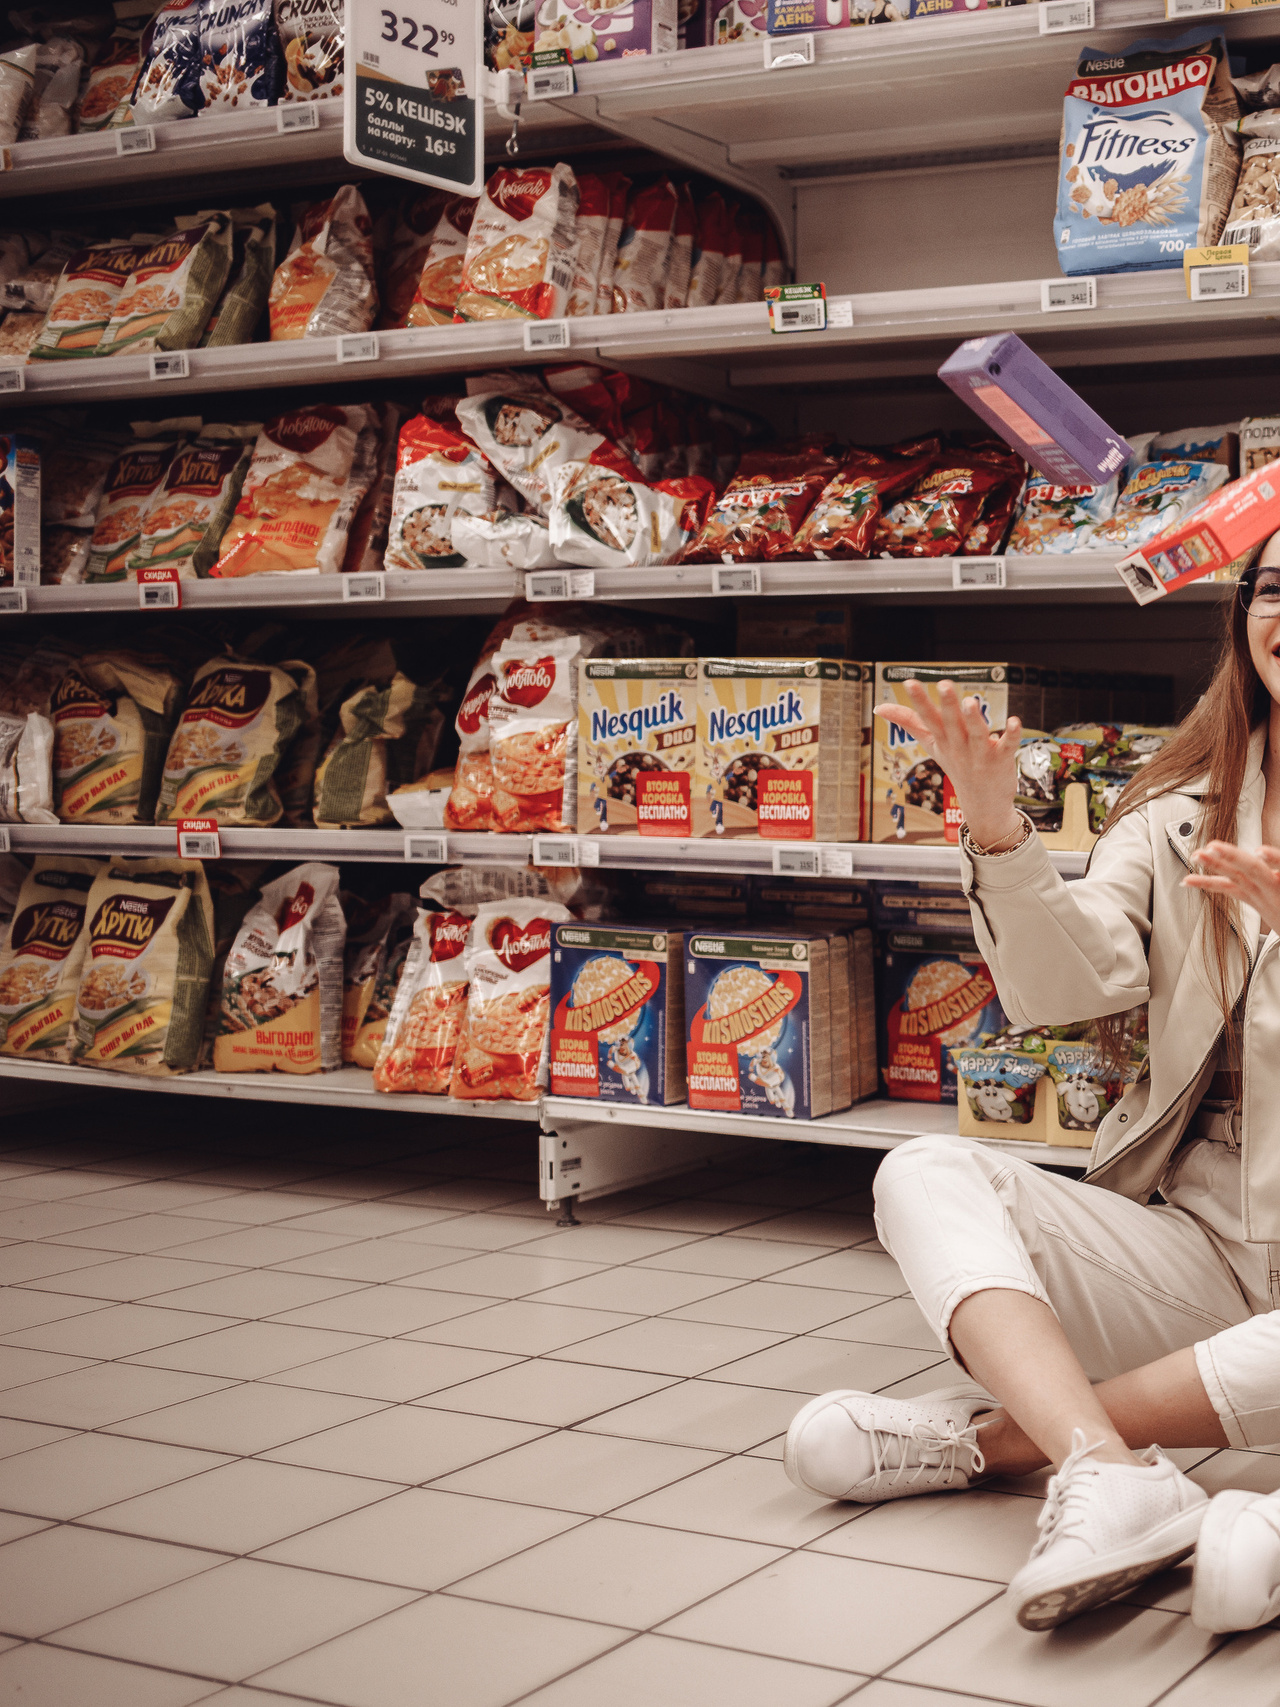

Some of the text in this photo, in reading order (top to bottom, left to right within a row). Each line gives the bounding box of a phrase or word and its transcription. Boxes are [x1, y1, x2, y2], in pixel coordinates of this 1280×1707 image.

[774, 13, 815, 27] ДЕНЬ
[1073, 59, 1208, 104] ВЫГОДНО
[365, 87, 467, 135] 5% КЕШБЭК
[368, 113, 405, 132] баллы
[367, 126, 416, 148] на карту:
[1077, 119, 1196, 163] Fitness
[143, 571, 173, 582] СКИДКА
[592, 691, 684, 742] Nesquik
[709, 691, 803, 743] Nesquik
[662, 729, 694, 747] DUO
[780, 729, 813, 748] DUO
[646, 780, 680, 793] ВТОРАЯ
[767, 779, 802, 793] ВТОРАЯ
[642, 793, 684, 804] КОРОБКА
[763, 792, 807, 804] КОРОБКА
[638, 805, 688, 821] БЕСПЛАТНО
[759, 805, 811, 821] БЕСПЛАТНО
[183, 820, 211, 831] СКИДКА
[565, 971, 653, 1033] KOSMOSTARS
[900, 974, 993, 1037] KOSMOSTARS
[702, 981, 795, 1045] KOSMOSTARS
[256, 1030, 314, 1046] ВЫГОДНО!
[559, 1039, 590, 1051] ВТОРАЯ
[556, 1051, 594, 1063] КОРОБКА
[696, 1051, 728, 1064] ВТОРАЯ
[960, 1056, 1000, 1073] Happy
[552, 1061, 597, 1079] БЕСПЛАТНО
[693, 1063, 733, 1076] КОРОБКА
[690, 1074, 738, 1092] БЕСПЛАТНО
